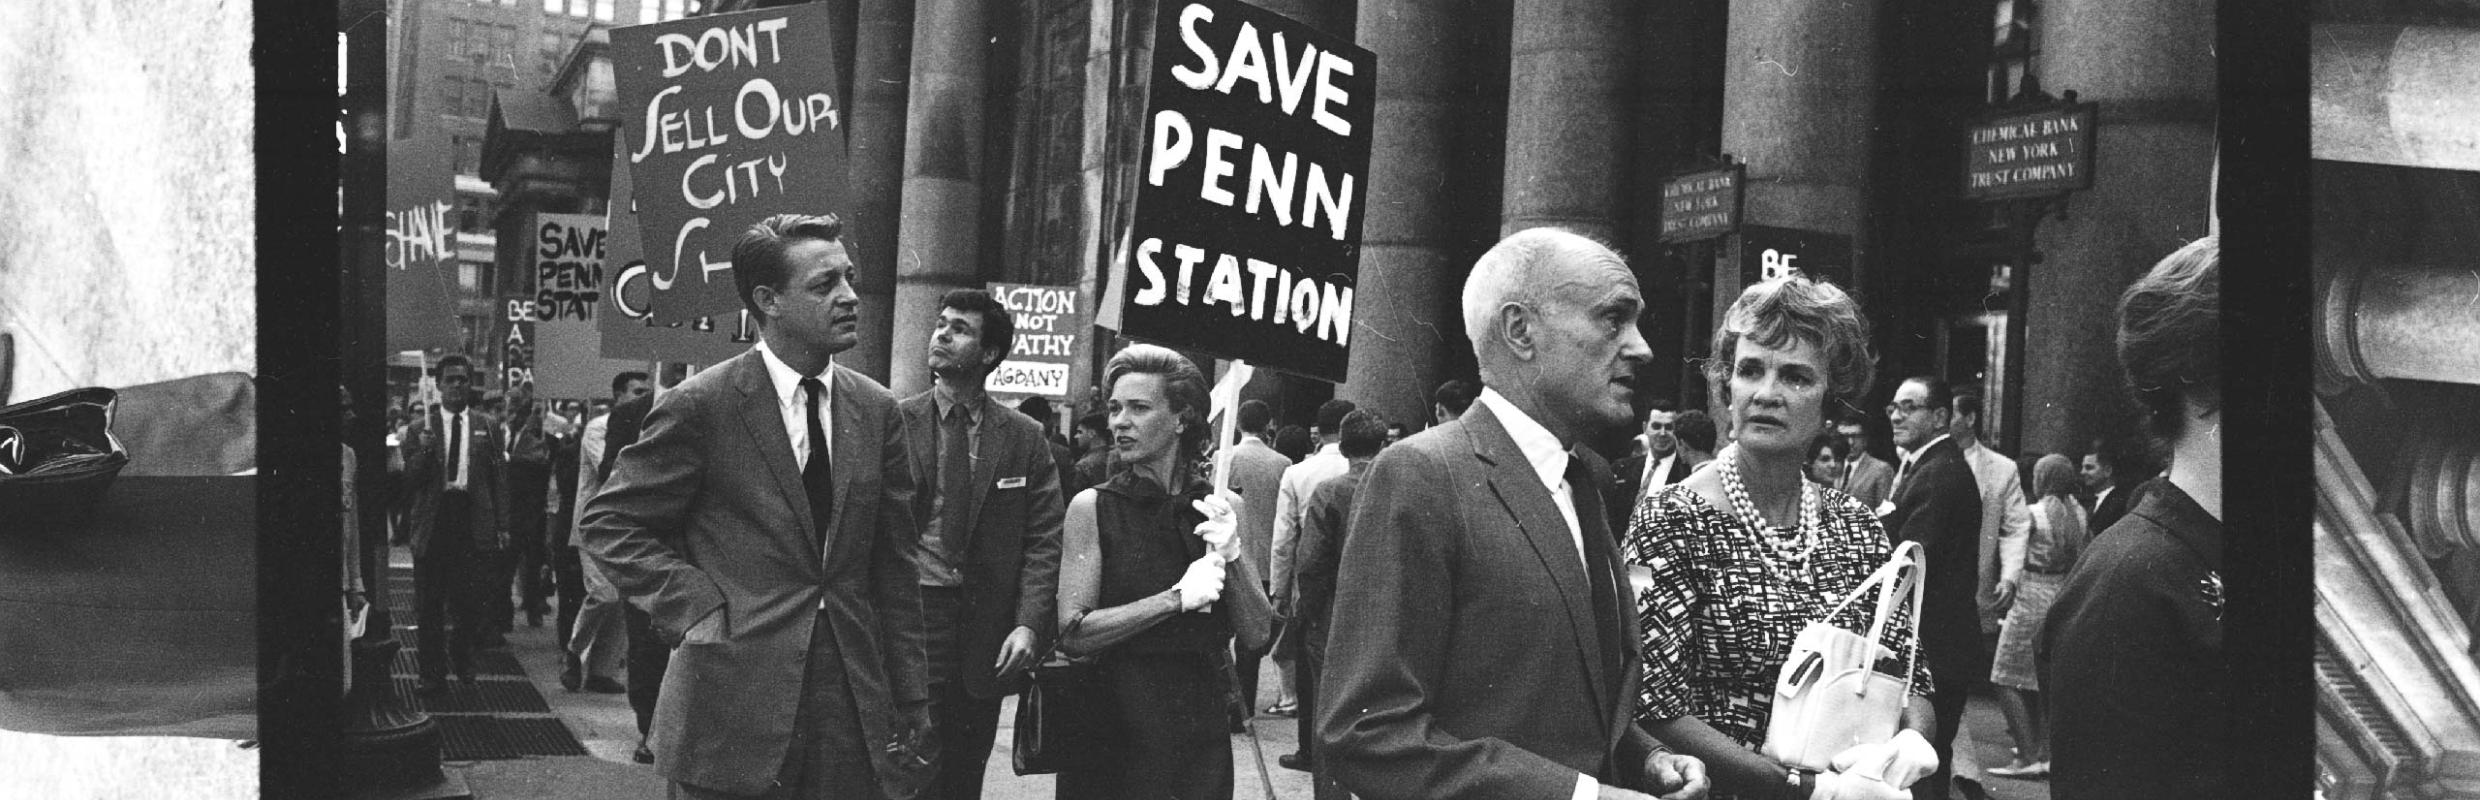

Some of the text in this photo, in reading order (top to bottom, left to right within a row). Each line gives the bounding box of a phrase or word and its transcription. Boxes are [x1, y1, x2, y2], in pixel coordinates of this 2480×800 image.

[654, 17, 788, 78] DONT
[1171, 3, 1354, 136] SAVE
[631, 78, 838, 163] SELL OUR
[2042, 117, 2078, 136] BANK
[1989, 142, 2058, 164] NEW YORK
[682, 152, 786, 209] CITY
[1149, 110, 1354, 240] PENN
[1972, 162, 2073, 188] TRUST COMPANY
[540, 222, 607, 259] SAVE
[1761, 248, 1798, 281] BE
[994, 286, 1076, 314] ACTION
[1134, 238, 1354, 346] STATION
[508, 300, 536, 322] BE
[1015, 313, 1058, 332] NOT
[507, 323, 525, 345] A
[1012, 334, 1075, 356] ATHY
[993, 367, 1063, 387] AGBANY
